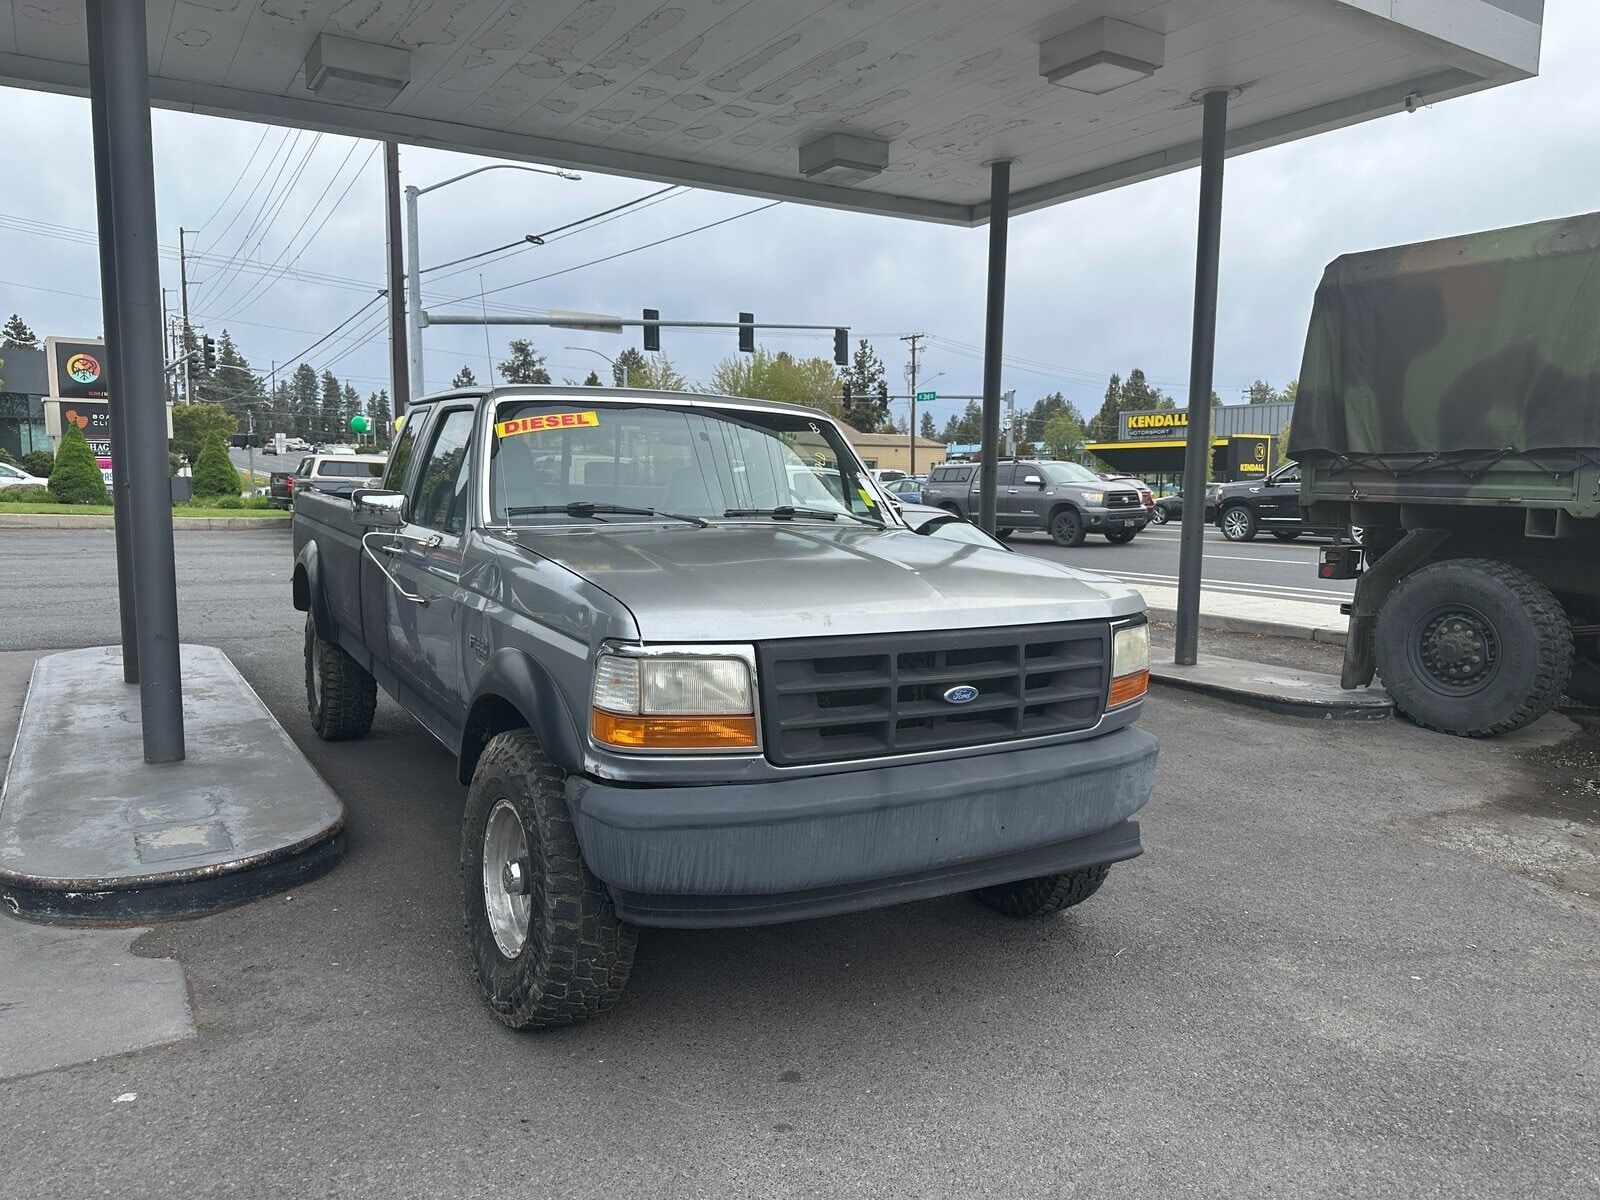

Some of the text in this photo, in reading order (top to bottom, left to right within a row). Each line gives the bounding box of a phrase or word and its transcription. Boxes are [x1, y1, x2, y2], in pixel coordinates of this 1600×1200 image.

[504, 413, 590, 435] DIESEL
[1128, 413, 1188, 428] KENDALL
[1240, 463, 1265, 472] KENDALL
[953, 689, 972, 700] Ford
